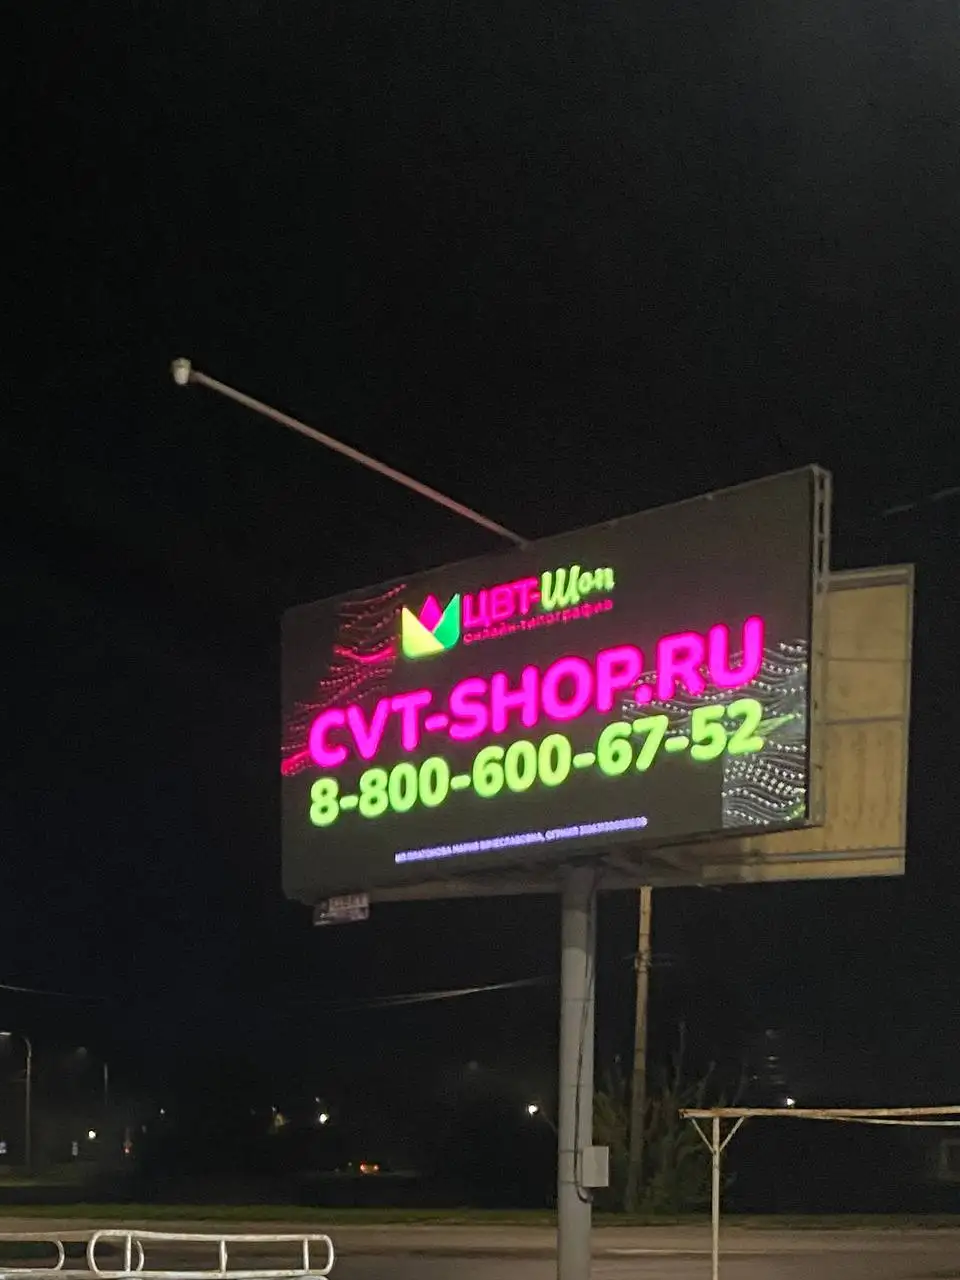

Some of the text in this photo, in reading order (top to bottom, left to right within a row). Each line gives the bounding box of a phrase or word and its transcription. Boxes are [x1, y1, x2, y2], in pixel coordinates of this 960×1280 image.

[462, 564, 616, 629] ЦВТ-Шоп
[308, 616, 766, 768] CVT-SHOP.RU
[309, 698, 764, 827] 8-800-600-67-52
